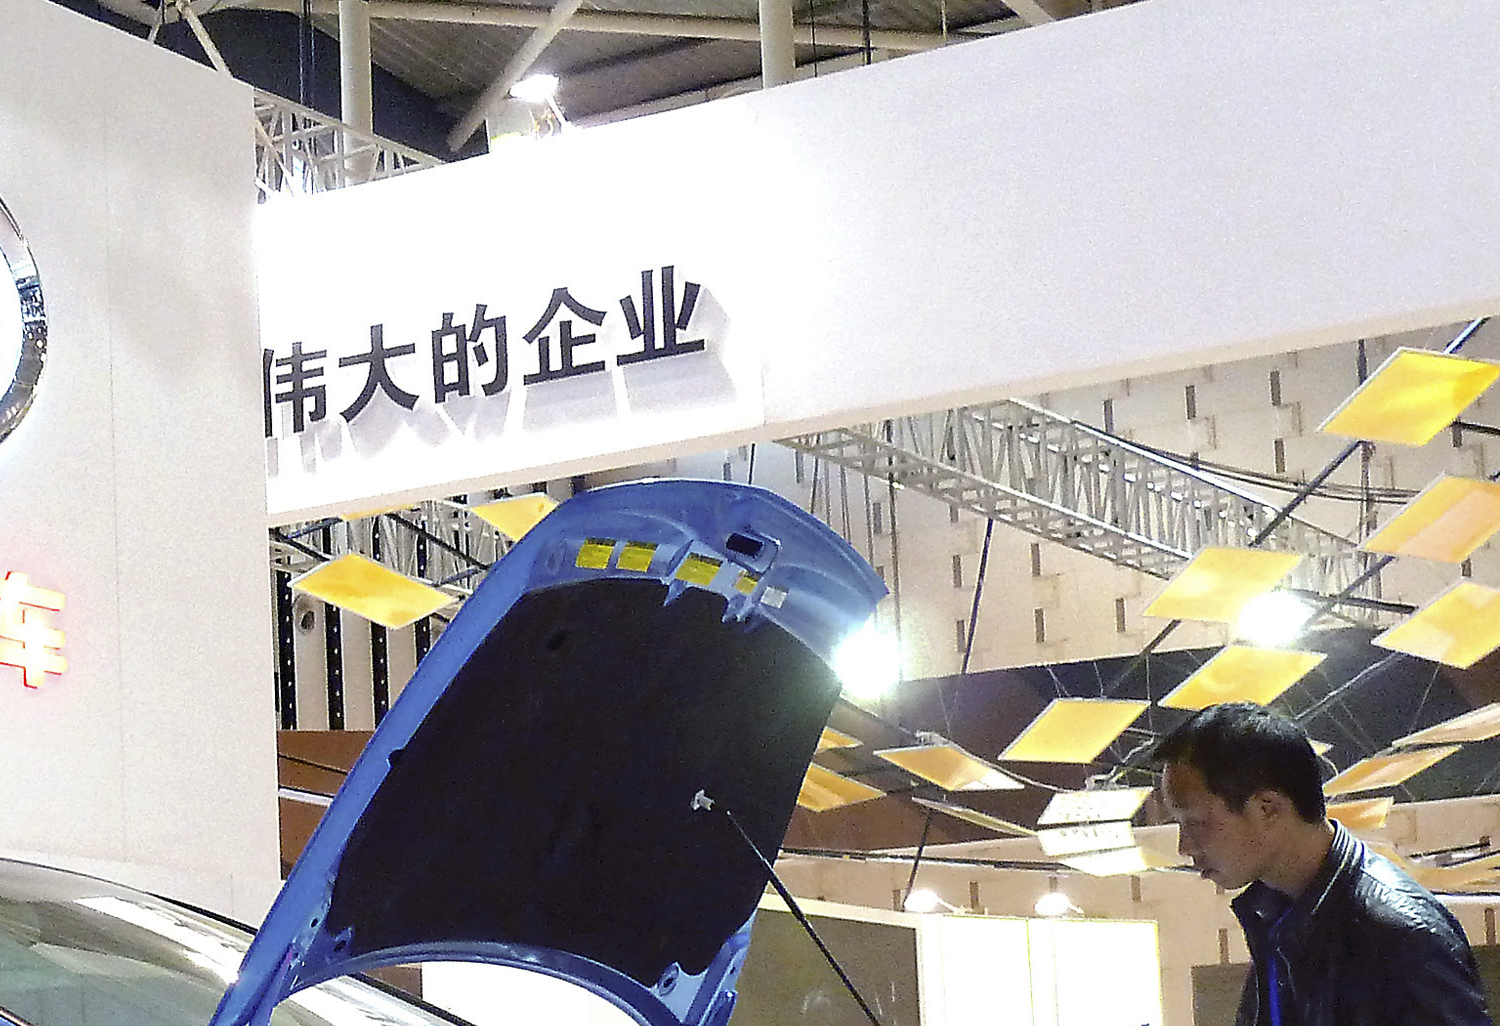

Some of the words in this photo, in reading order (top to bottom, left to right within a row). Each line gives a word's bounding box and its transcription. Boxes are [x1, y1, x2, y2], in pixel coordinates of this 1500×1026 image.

[264, 264, 705, 438] 伟大的企业
